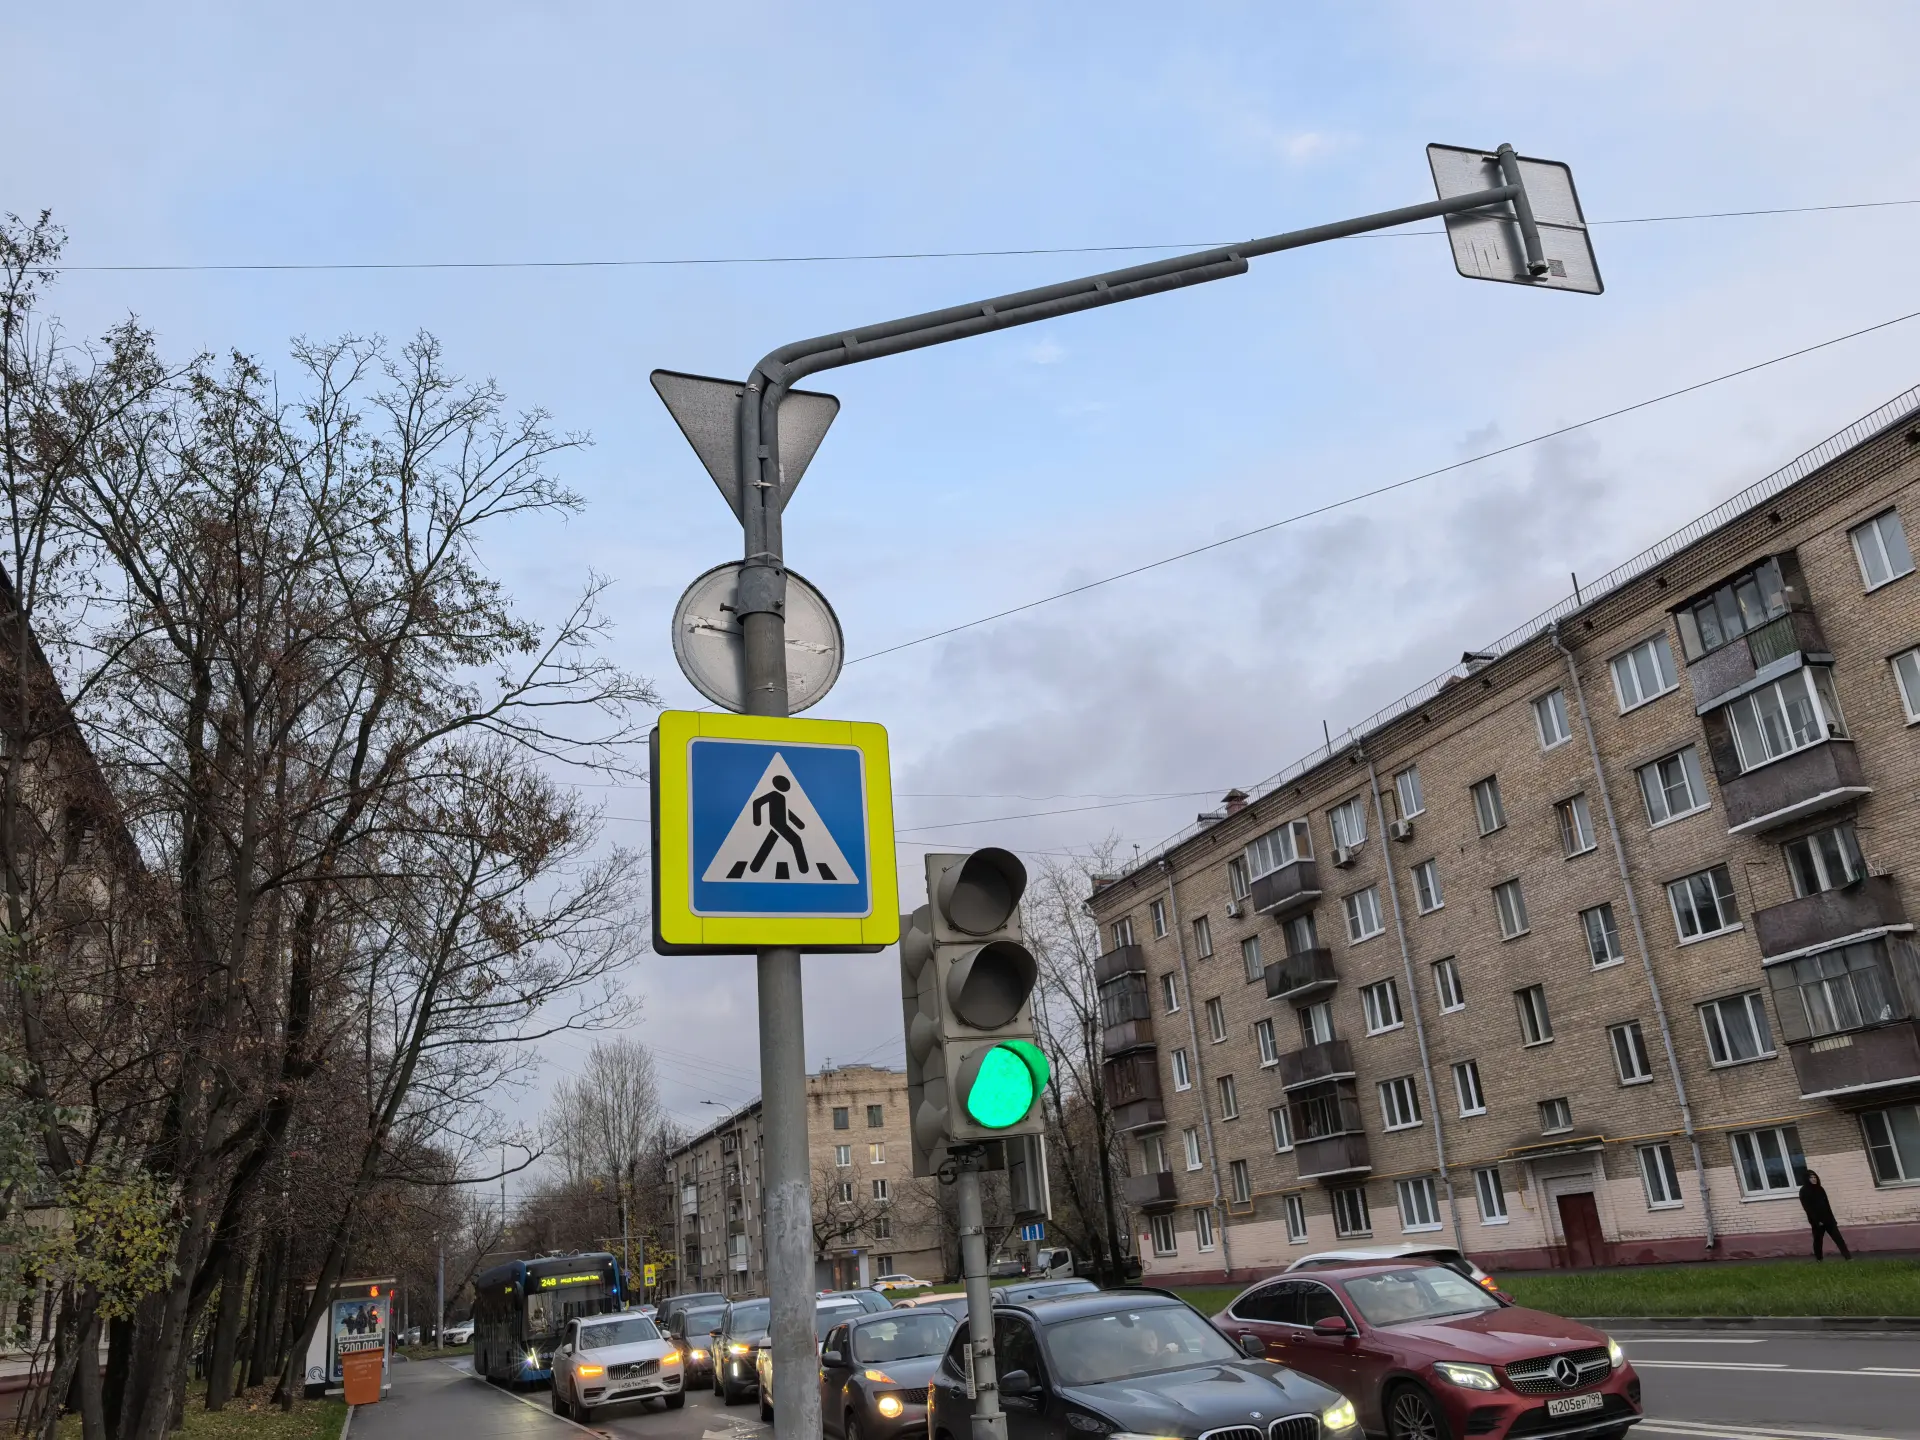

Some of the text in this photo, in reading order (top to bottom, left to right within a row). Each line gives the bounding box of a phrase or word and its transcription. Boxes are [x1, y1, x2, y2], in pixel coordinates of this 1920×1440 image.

[541, 1278, 556, 1287] 248
[1552, 1393, 1600, 1414] Н205ВР 799
